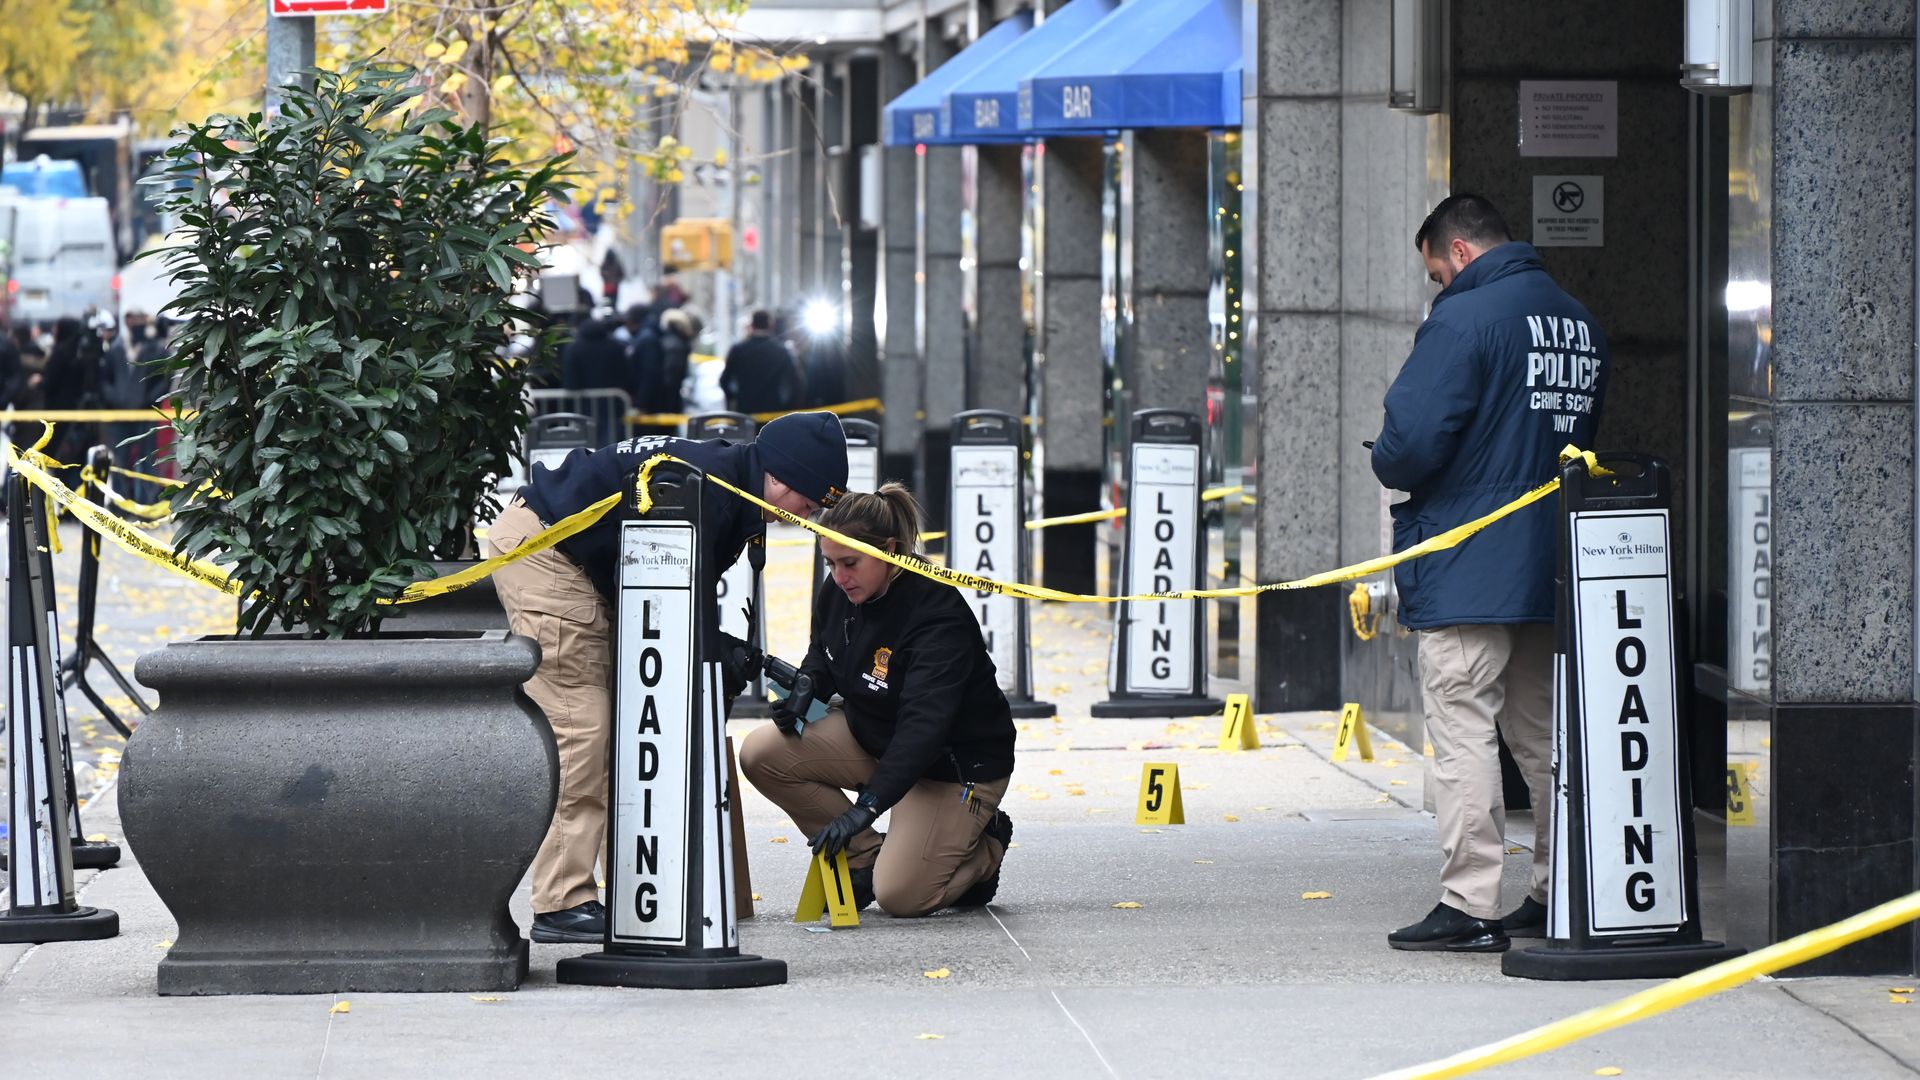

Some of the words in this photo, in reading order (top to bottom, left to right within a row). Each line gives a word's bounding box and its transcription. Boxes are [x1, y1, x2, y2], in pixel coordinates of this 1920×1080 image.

[974, 99, 1000, 128] BAR
[1062, 86, 1091, 118] BAR
[1526, 315, 1596, 353] N.Y.P.D.
[1526, 352, 1601, 391] POLICE
[641, 555, 659, 565] York
[660, 555, 688, 565] Hilton
[1582, 546, 1607, 556] New
[1609, 544, 1633, 555] York
[1634, 544, 1664, 554] Hilton
[975, 494, 996, 653] LOADI
[1151, 492, 1174, 680] LOADING
[1228, 703, 1241, 739] 7
[1339, 710, 1352, 747] 6
[635, 600, 662, 923] LOADING
[1615, 590, 1656, 912] LOADING
[1146, 769, 1164, 812] 5
[829, 854, 845, 906] 1
